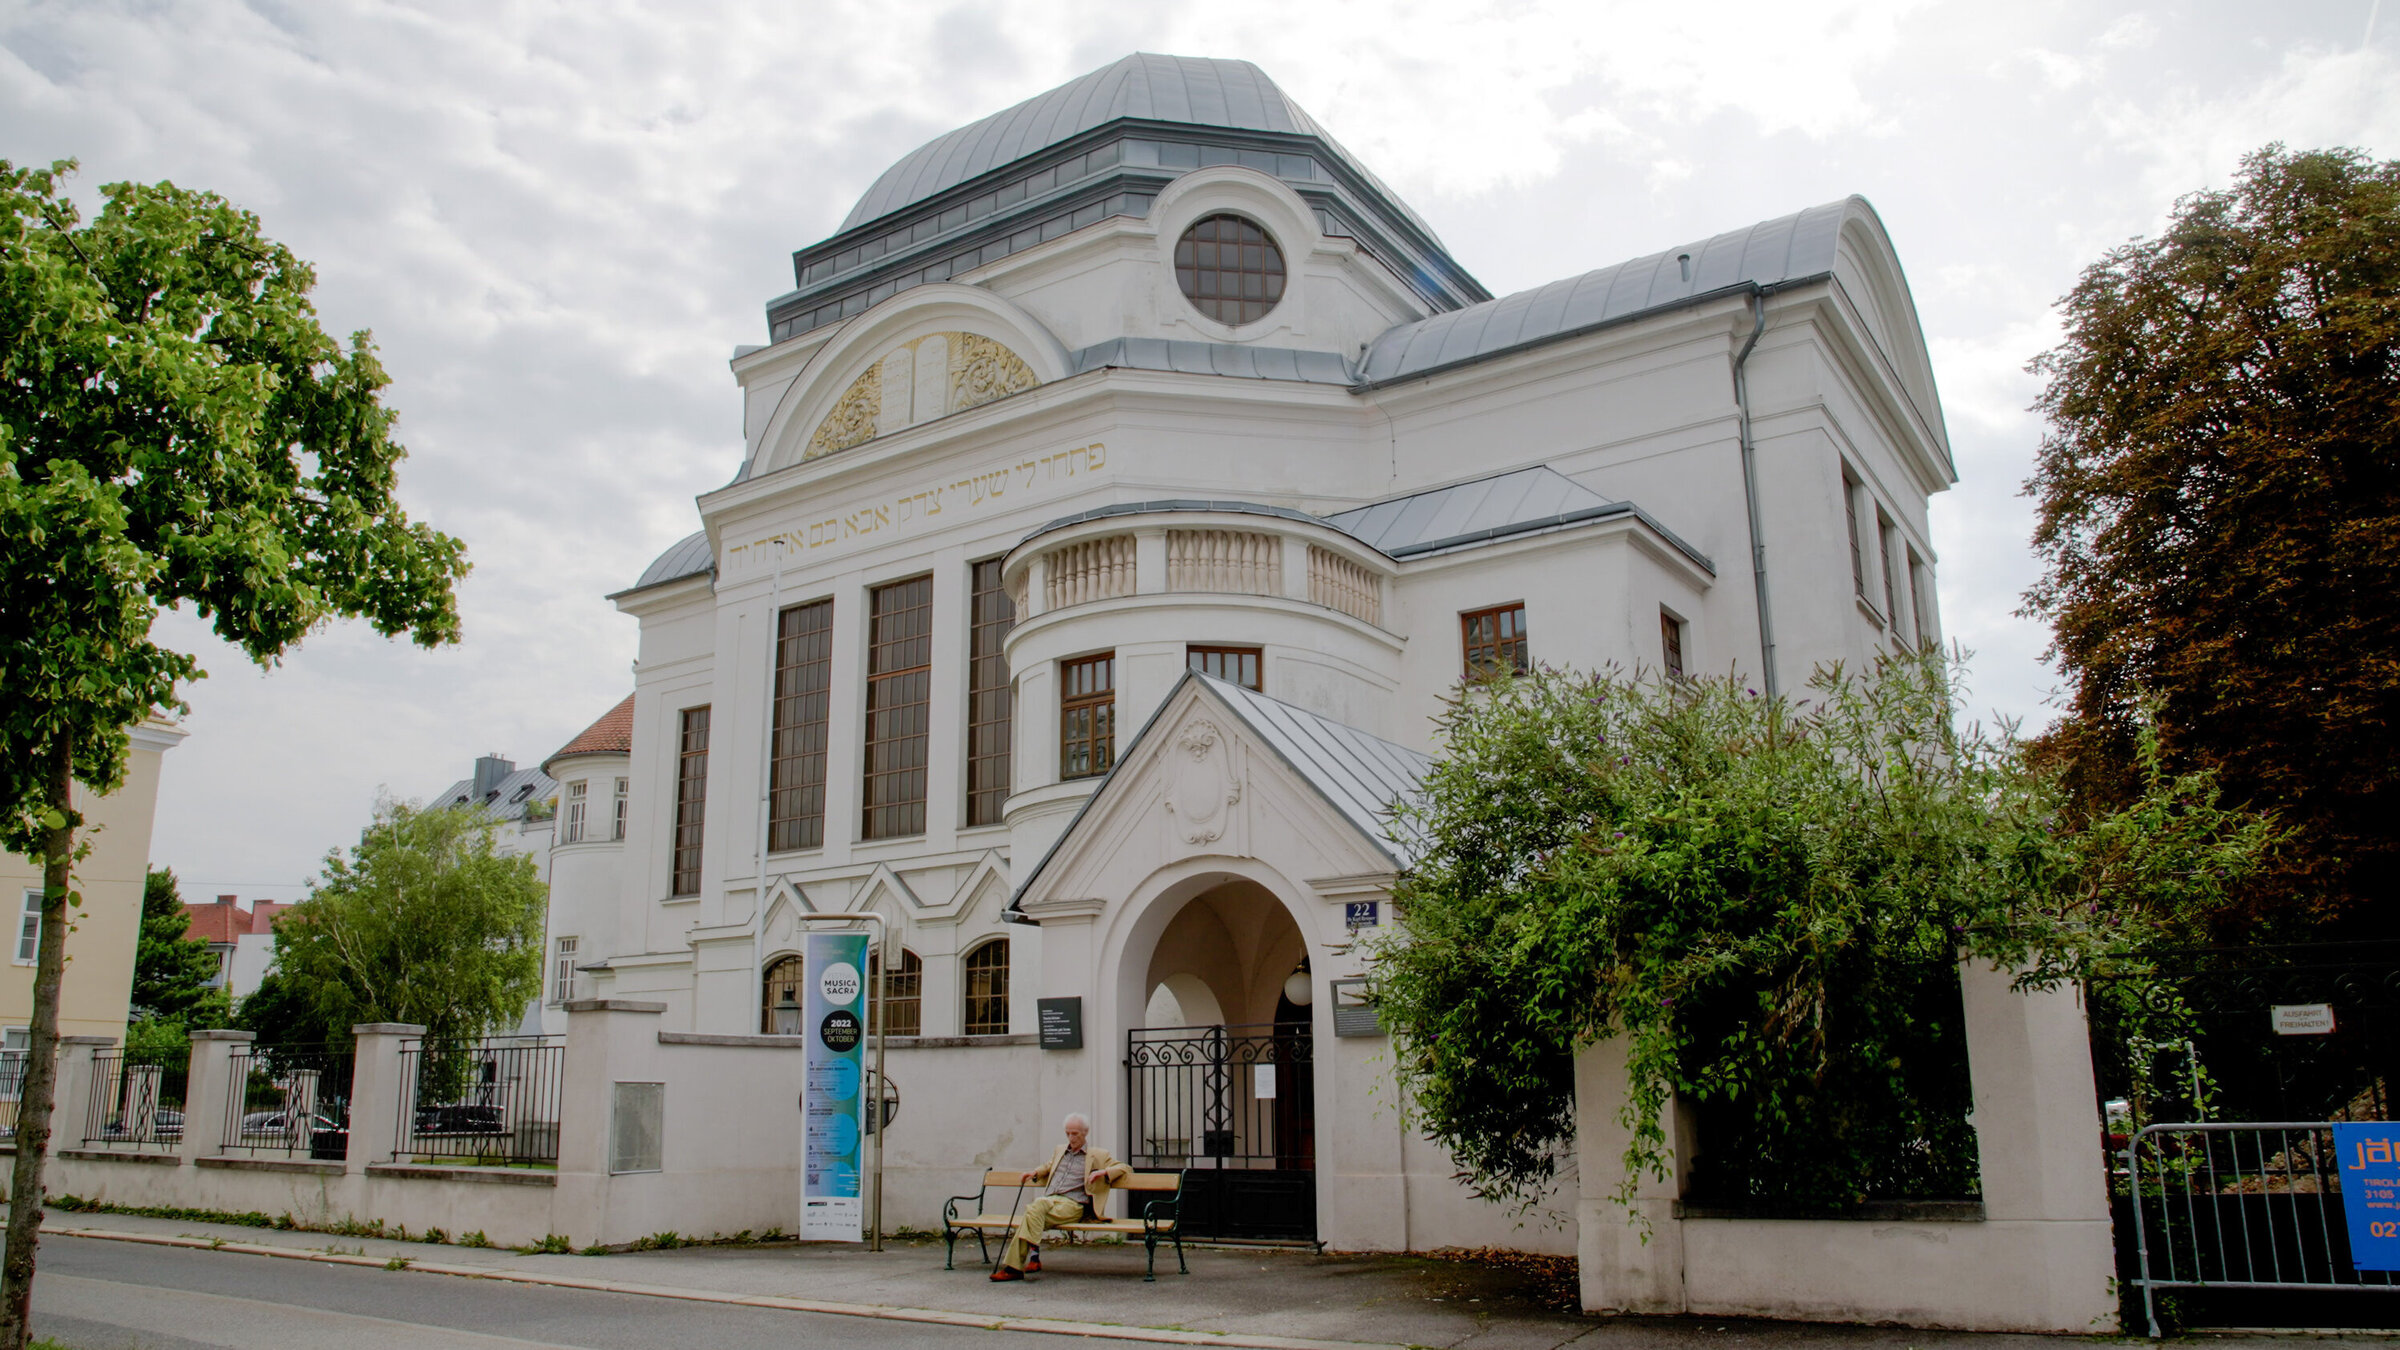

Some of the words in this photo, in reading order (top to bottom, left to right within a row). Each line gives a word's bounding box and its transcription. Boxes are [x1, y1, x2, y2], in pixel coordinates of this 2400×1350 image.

[1040, 442, 1106, 481] פתחו
[1015, 458, 1036, 489] לי
[949, 468, 1009, 507] שערי
[898, 487, 943, 534] צדק
[1354, 903, 1370, 916] 22
[2282, 1009, 2322, 1018] AUSFAHRT
[831, 1019, 852, 1027] 2022
[2364, 1189, 2395, 1199] 3105
[2367, 1202, 2400, 1210] www.j
[2370, 1221, 2400, 1238] 02
